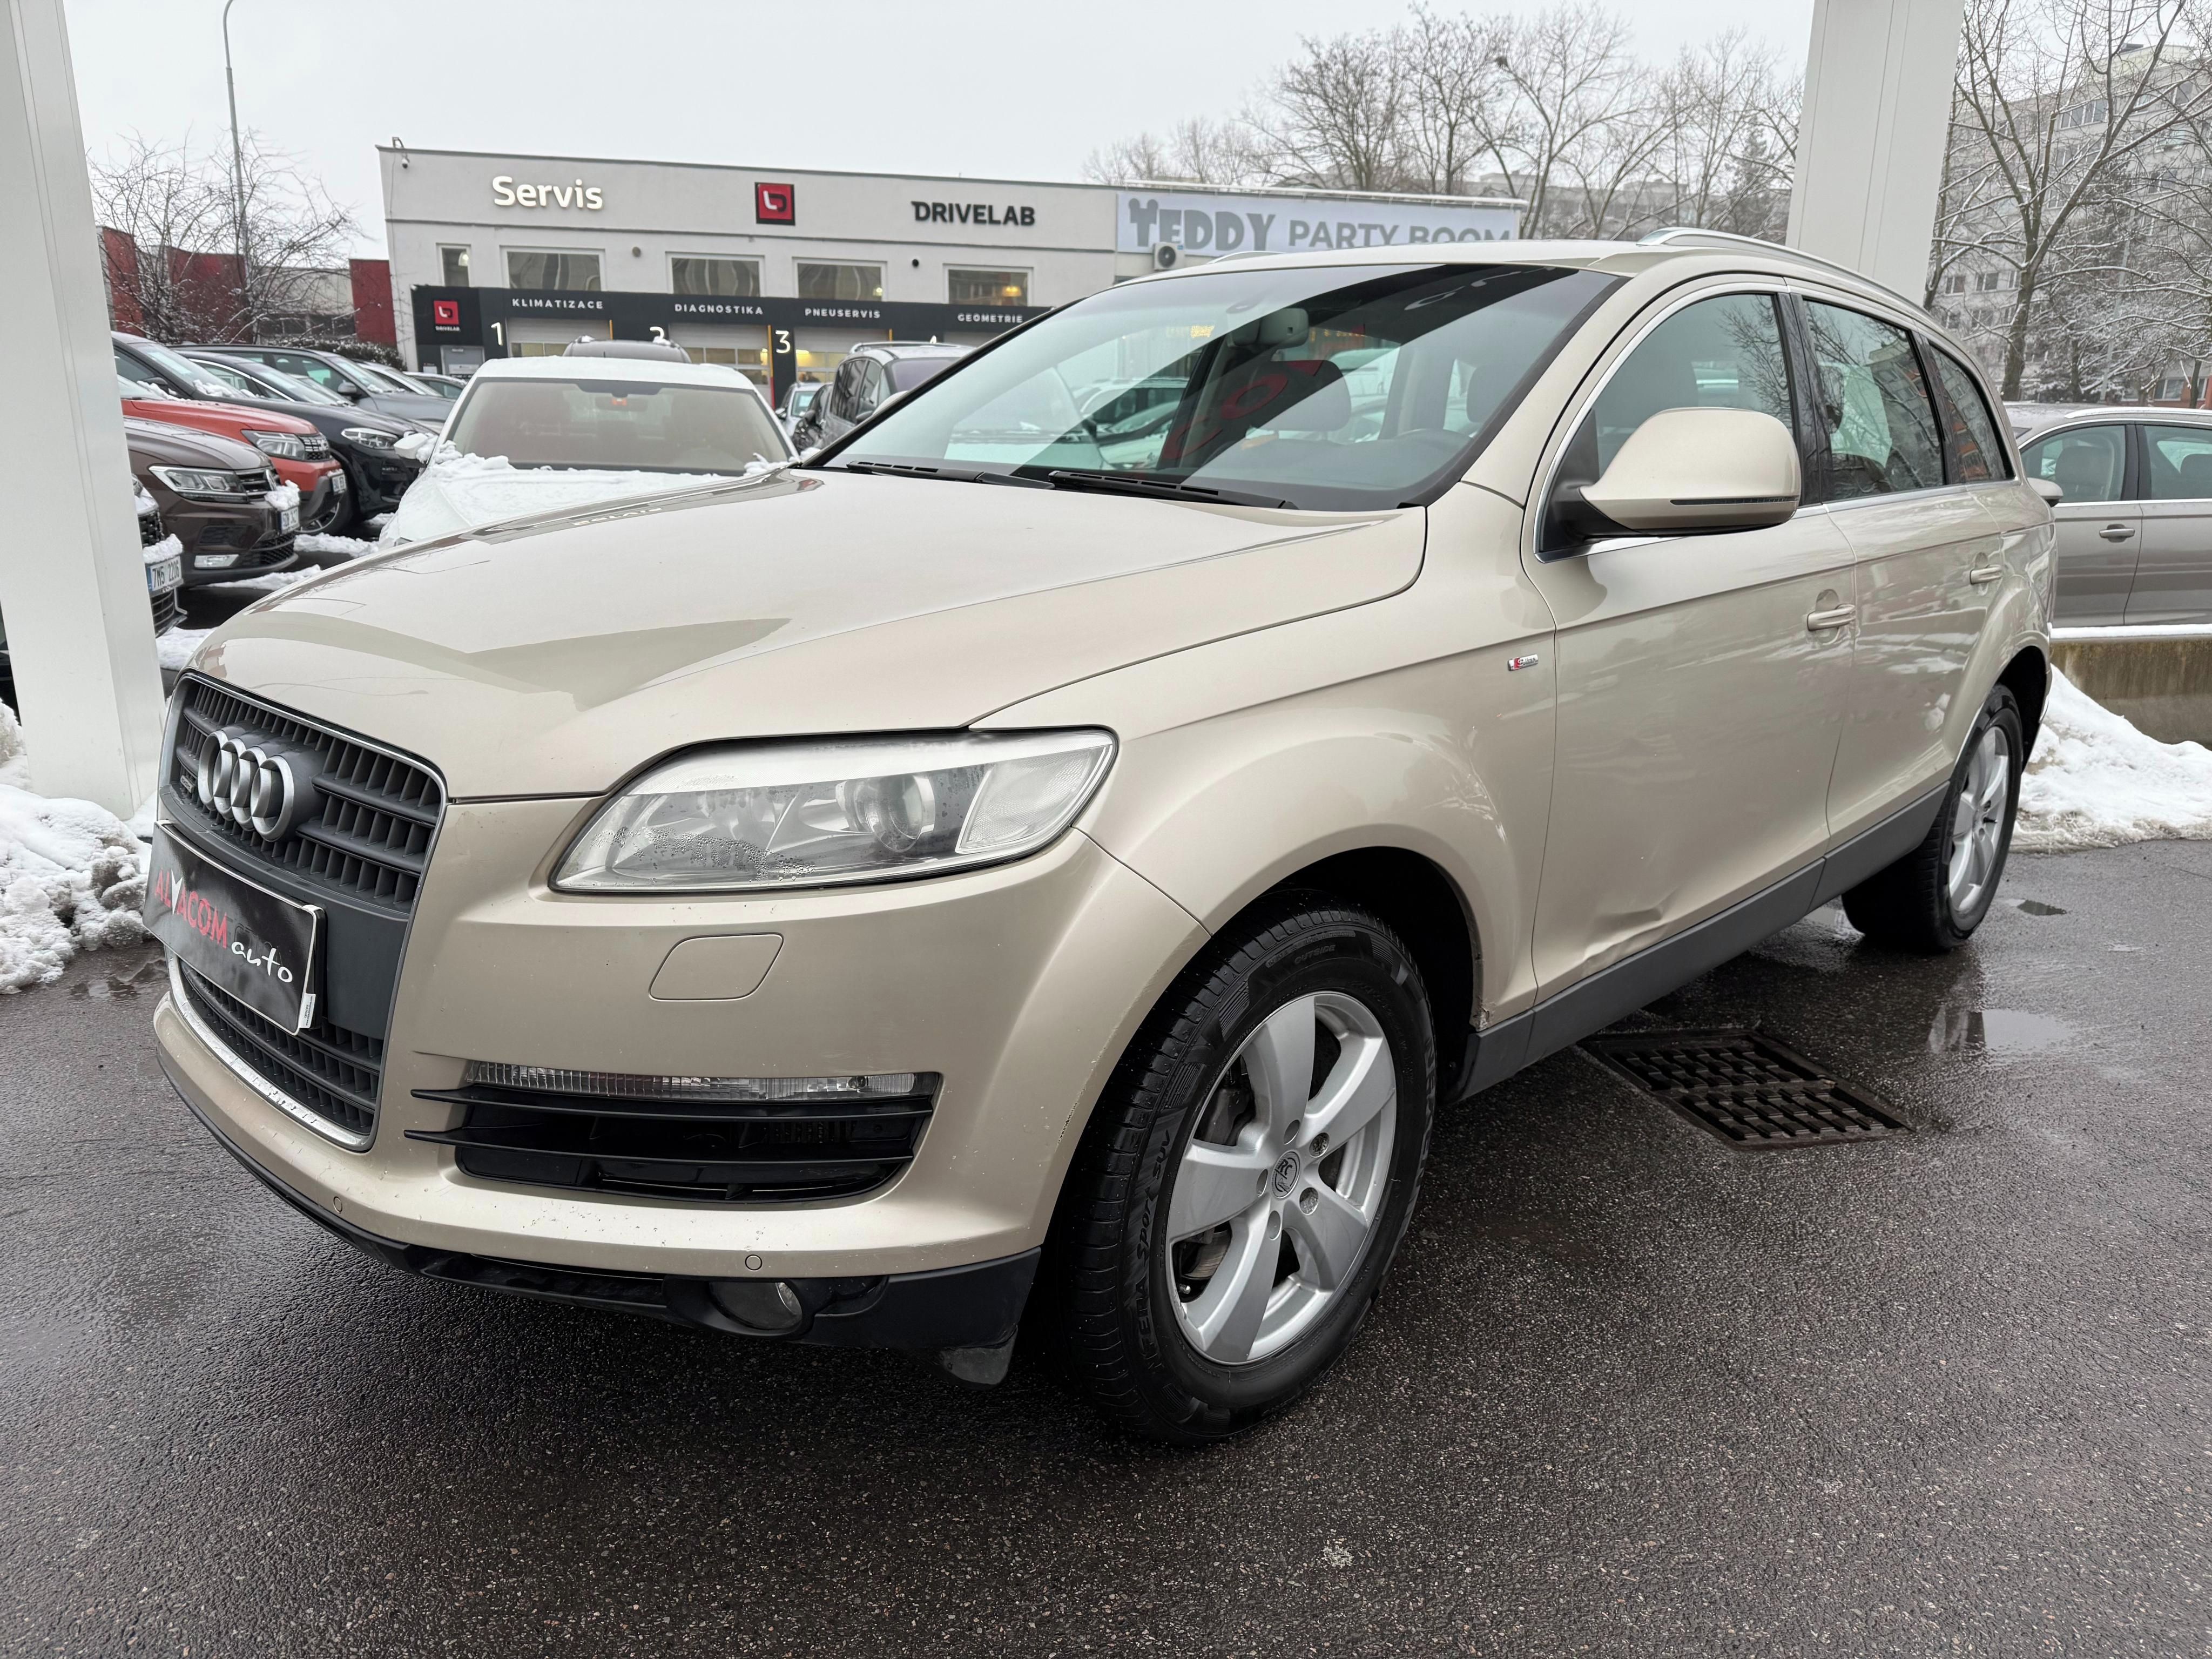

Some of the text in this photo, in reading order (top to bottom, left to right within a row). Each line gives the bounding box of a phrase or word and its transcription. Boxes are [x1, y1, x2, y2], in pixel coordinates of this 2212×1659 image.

[492, 176, 603, 210] Servis
[911, 201, 1035, 226] DRIVELAB
[1128, 198, 1276, 251] TEDDY
[1288, 220, 1399, 248] PARTY
[512, 298, 603, 309] KLIMATIZACE
[675, 304, 763, 315] DIAGNOSTIKA
[805, 308, 881, 319] PNEUSERVIS
[957, 313, 1023, 323] GEOMETRIE
[491, 322, 503, 346] 1
[775, 329, 791, 354] 3
[231, 941, 293, 983] auto
[1294, 945, 1336, 964] OUTSIDE
